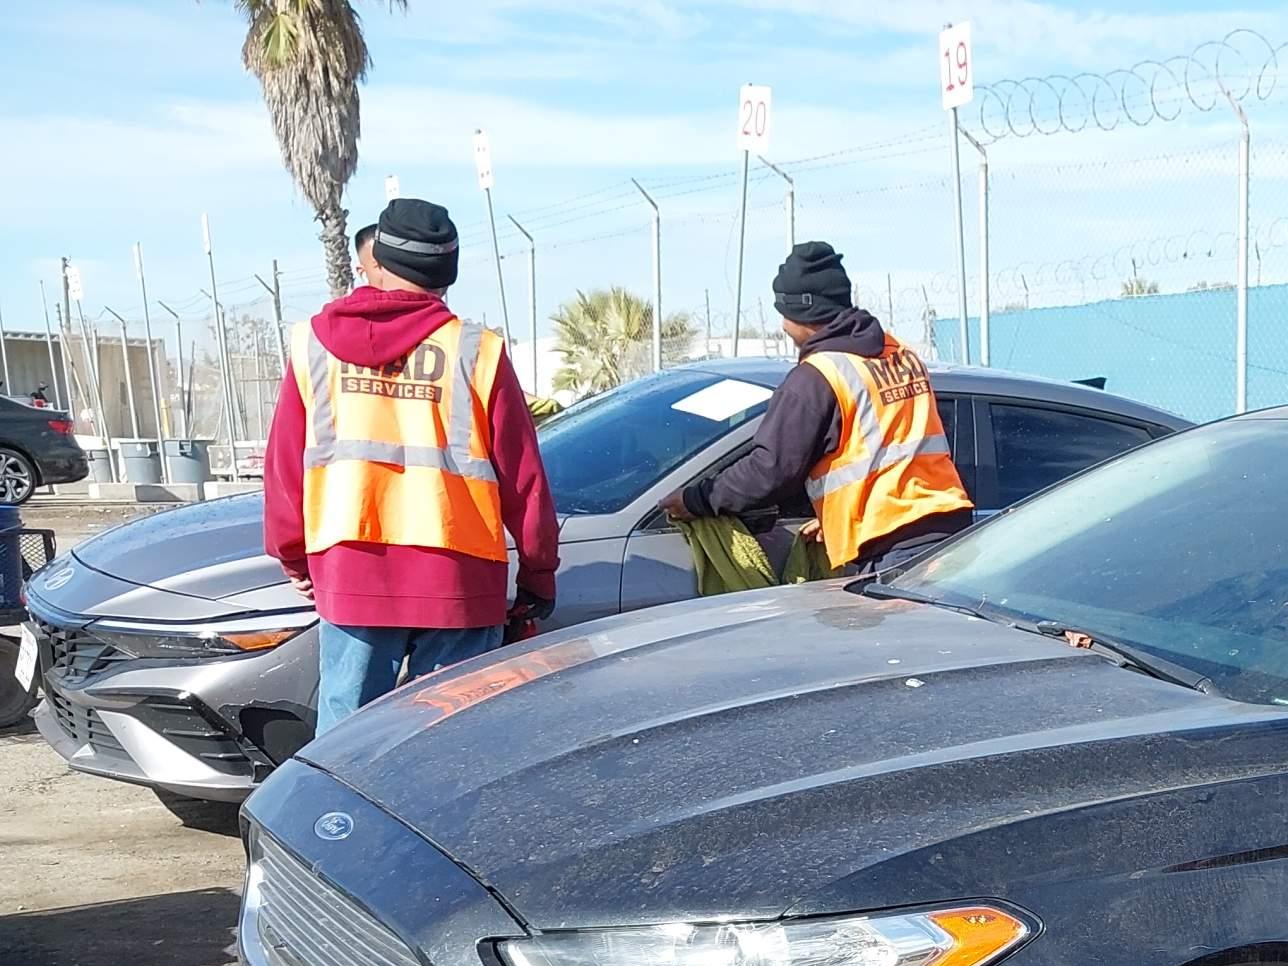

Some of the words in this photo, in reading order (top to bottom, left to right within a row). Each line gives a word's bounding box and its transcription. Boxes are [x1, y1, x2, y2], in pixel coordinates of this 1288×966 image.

[944, 41, 968, 92] 19
[742, 100, 766, 137] 20
[346, 379, 436, 399] SERVICES
[884, 381, 930, 403] SERVICE
